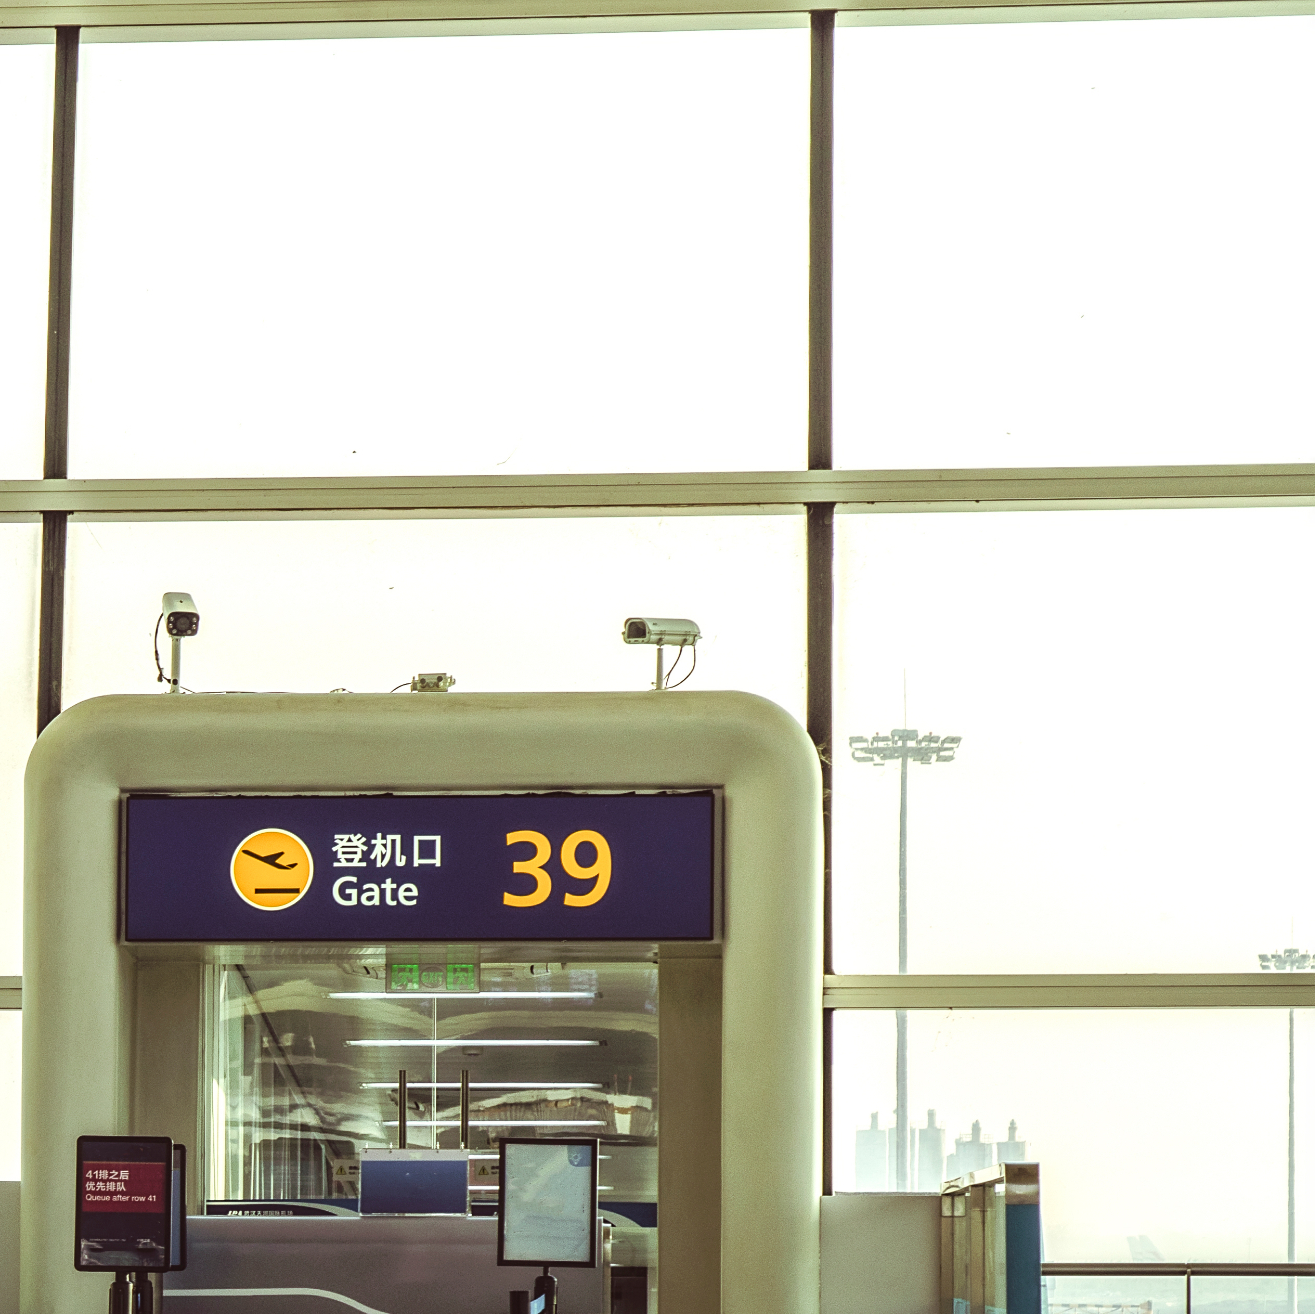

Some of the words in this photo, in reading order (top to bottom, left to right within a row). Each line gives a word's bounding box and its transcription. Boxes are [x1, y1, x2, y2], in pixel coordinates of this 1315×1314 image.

[331, 832, 442, 868] 登机口
[502, 829, 612, 908] 39
[332, 875, 419, 906] Gate
[85, 1170, 129, 1180] 41排之后
[85, 1182, 126, 1192] 优先排队
[85, 1193, 111, 1201] Queue
